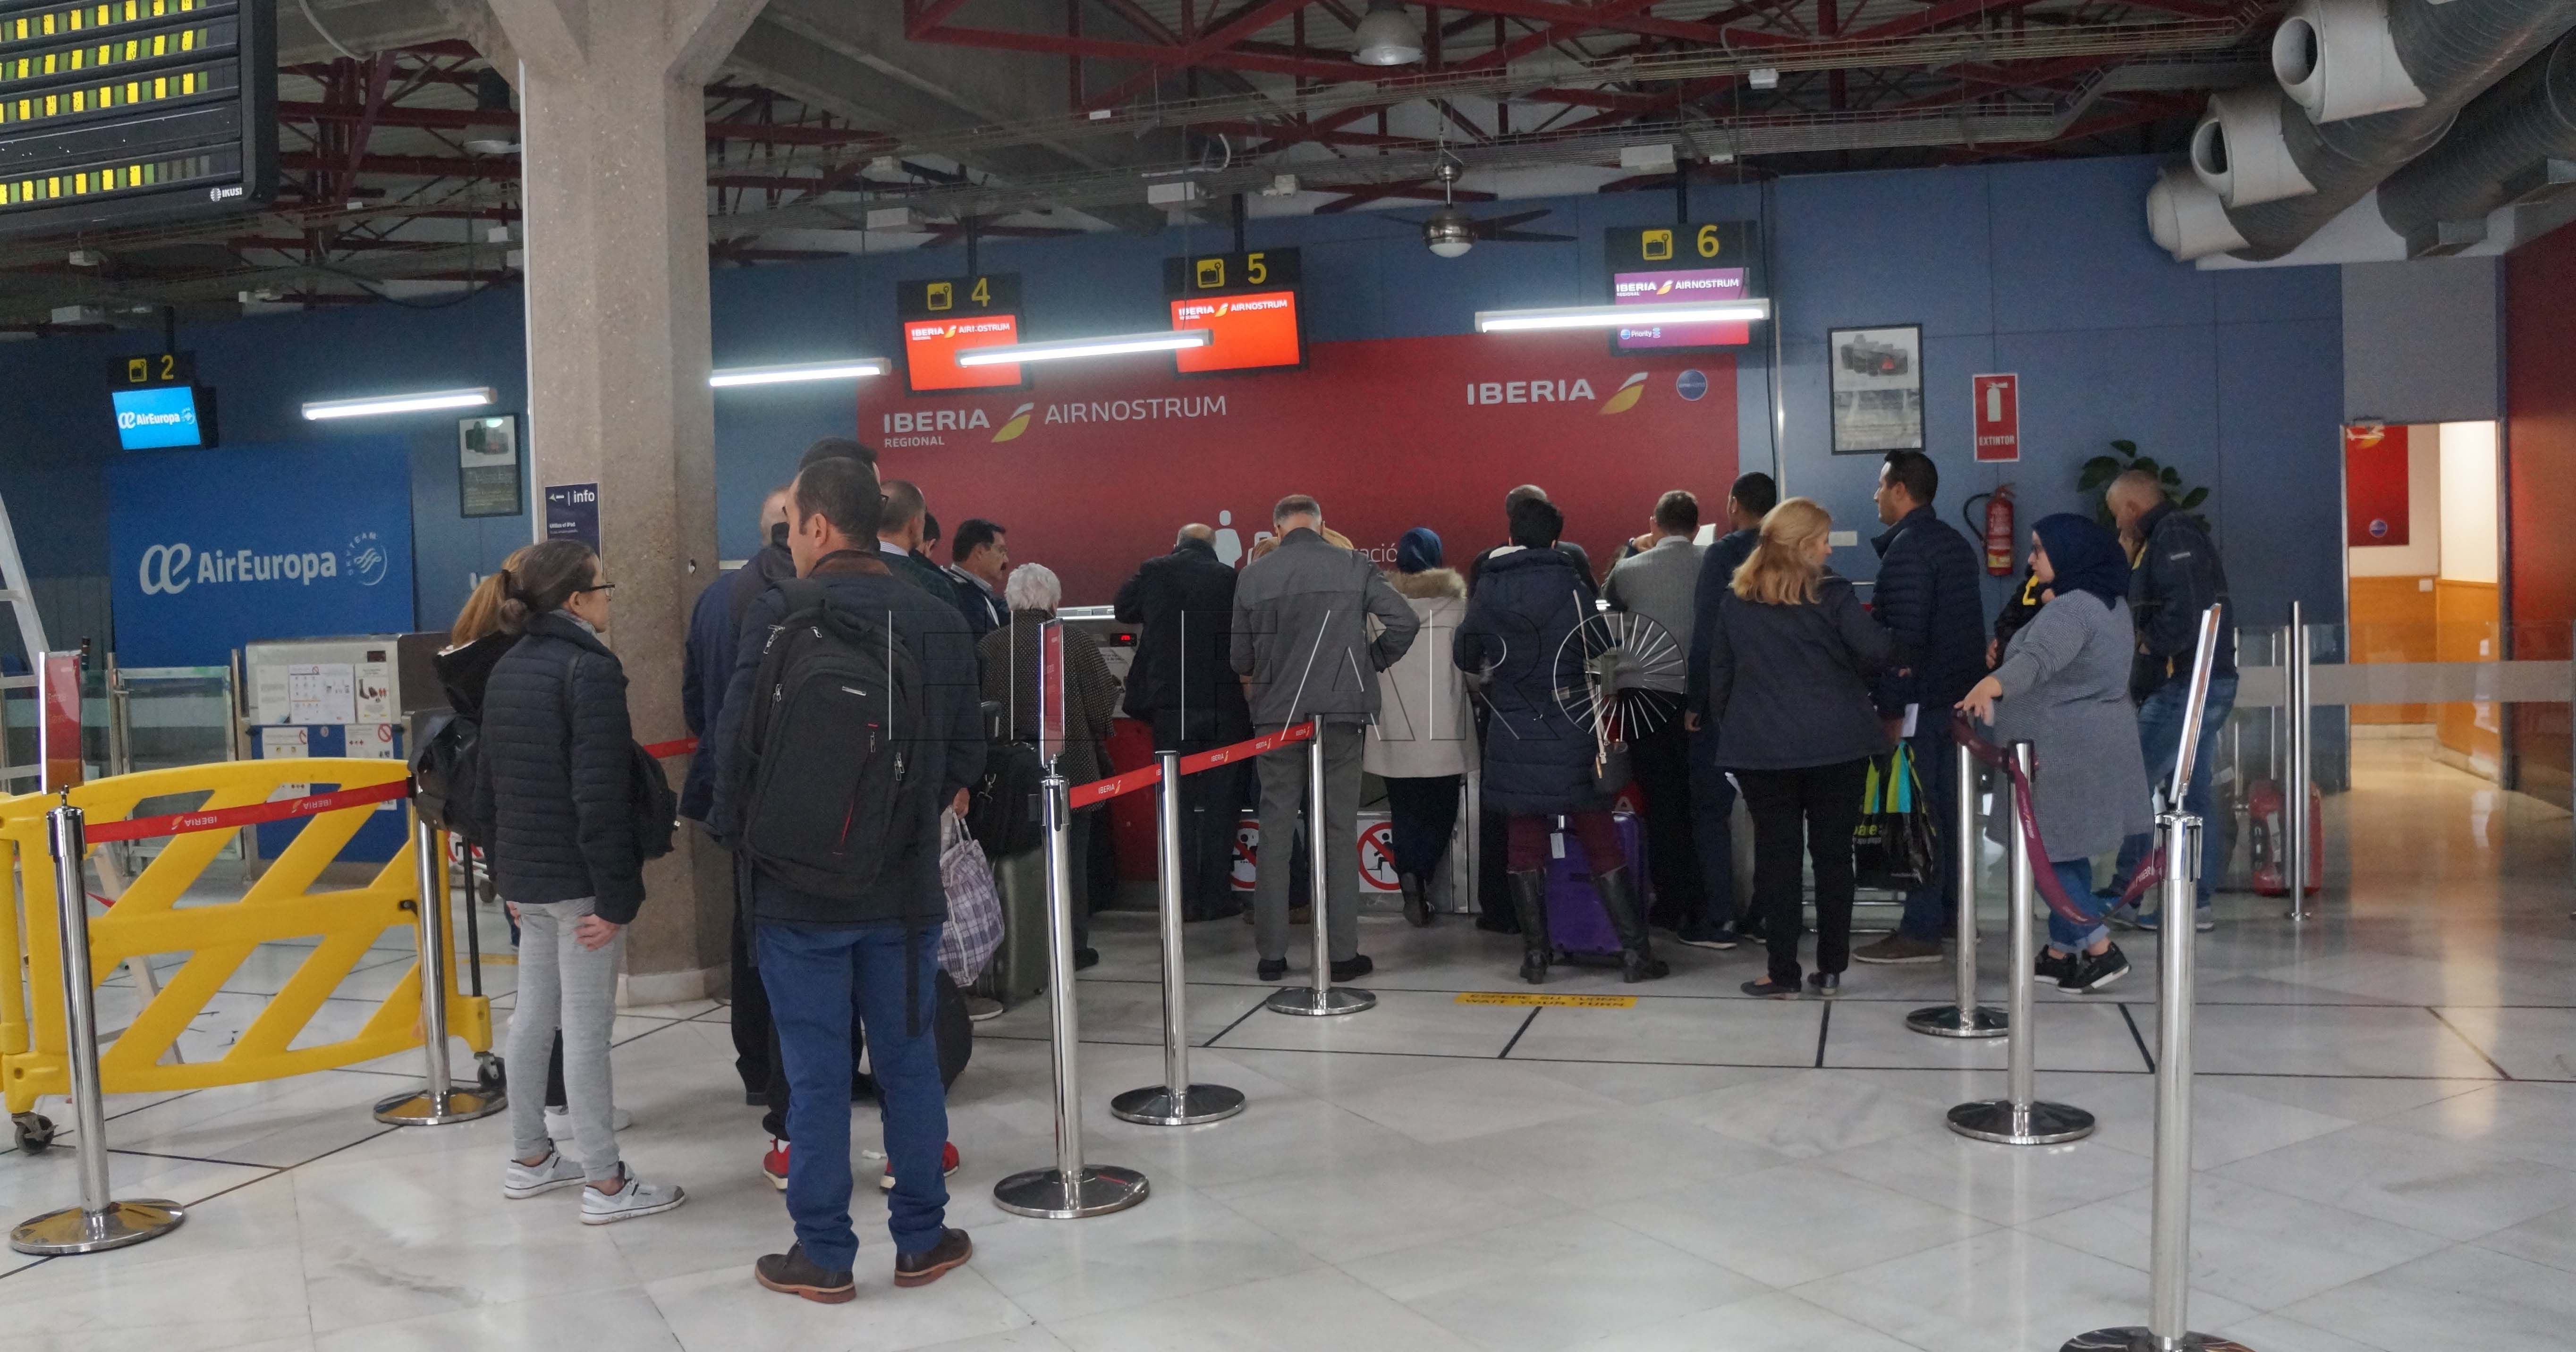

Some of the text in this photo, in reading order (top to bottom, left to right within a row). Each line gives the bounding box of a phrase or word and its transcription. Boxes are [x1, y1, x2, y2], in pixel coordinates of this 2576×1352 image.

[222, 187, 242, 197] IKUSI
[1697, 225, 1720, 258] 6
[1248, 253, 1267, 284] 5
[1616, 278, 1739, 292] IBERIA AIRNOSTRUM
[971, 278, 991, 307] 4
[1178, 299, 1288, 316] IBERIA AIRNOSTRUM
[911, 327, 944, 337] IBERIA
[1631, 330, 1652, 338] Priority
[161, 355, 174, 380] 2
[1466, 378, 1596, 405] IBERIA
[136, 413, 180, 425] AirEuropa
[884, 396, 1227, 433] IBERIA AIRNOSTRUM
[884, 436, 945, 448] REGIONAL
[1979, 435, 2015, 446] EXTINTOR
[573, 490, 595, 503] info
[197, 549, 337, 586] AirEuropa
[1255, 740, 1267, 750] IBERIA
[1211, 753, 1224, 762] IBERIA
[1098, 784, 1115, 794] IBERIA
[303, 799, 331, 810] IBERIA
[184, 815, 217, 827] IBERIA
